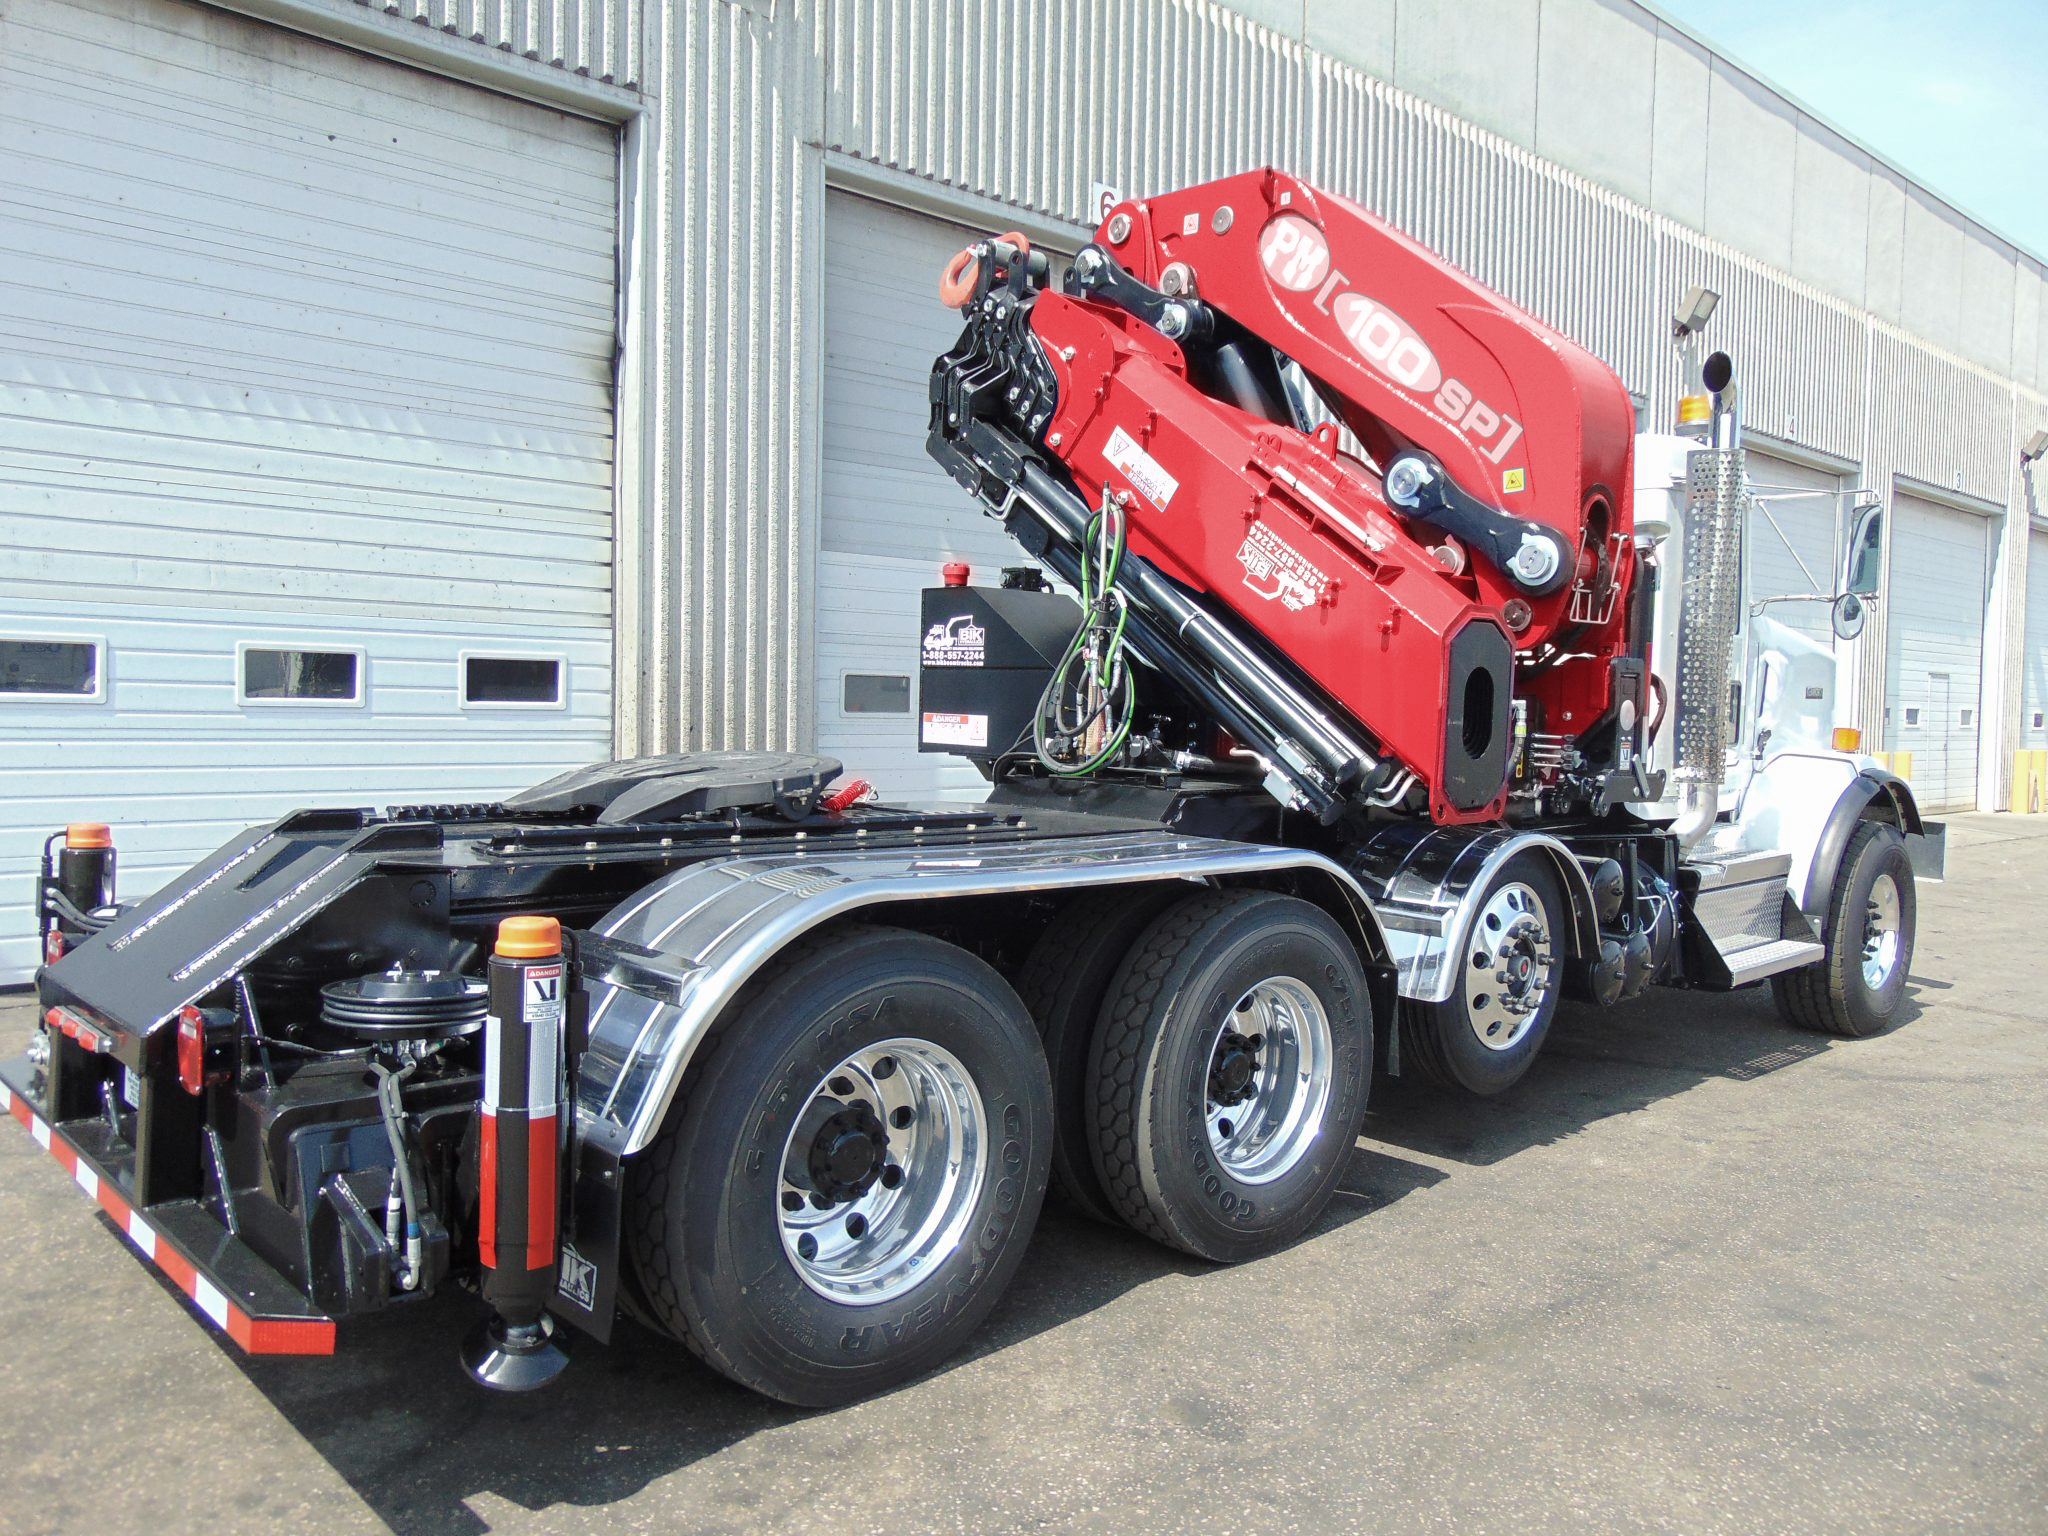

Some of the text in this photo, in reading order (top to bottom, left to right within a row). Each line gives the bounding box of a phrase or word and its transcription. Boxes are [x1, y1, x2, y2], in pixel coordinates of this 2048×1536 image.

[1100, 191, 1115, 221] 6
[1262, 219, 1328, 288] PM
[1126, 470, 1153, 498] DANGER
[1240, 543, 1270, 577] BIK
[1249, 525, 1326, 594] 1-888-557-2244
[1254, 519, 1329, 582] www.bikboomtrucks.com
[960, 629, 983, 641] BIK
[922, 650, 985, 660] 1-888-557-2244
[935, 714, 961, 724] DANGER
[535, 969, 560, 977] DANGER
